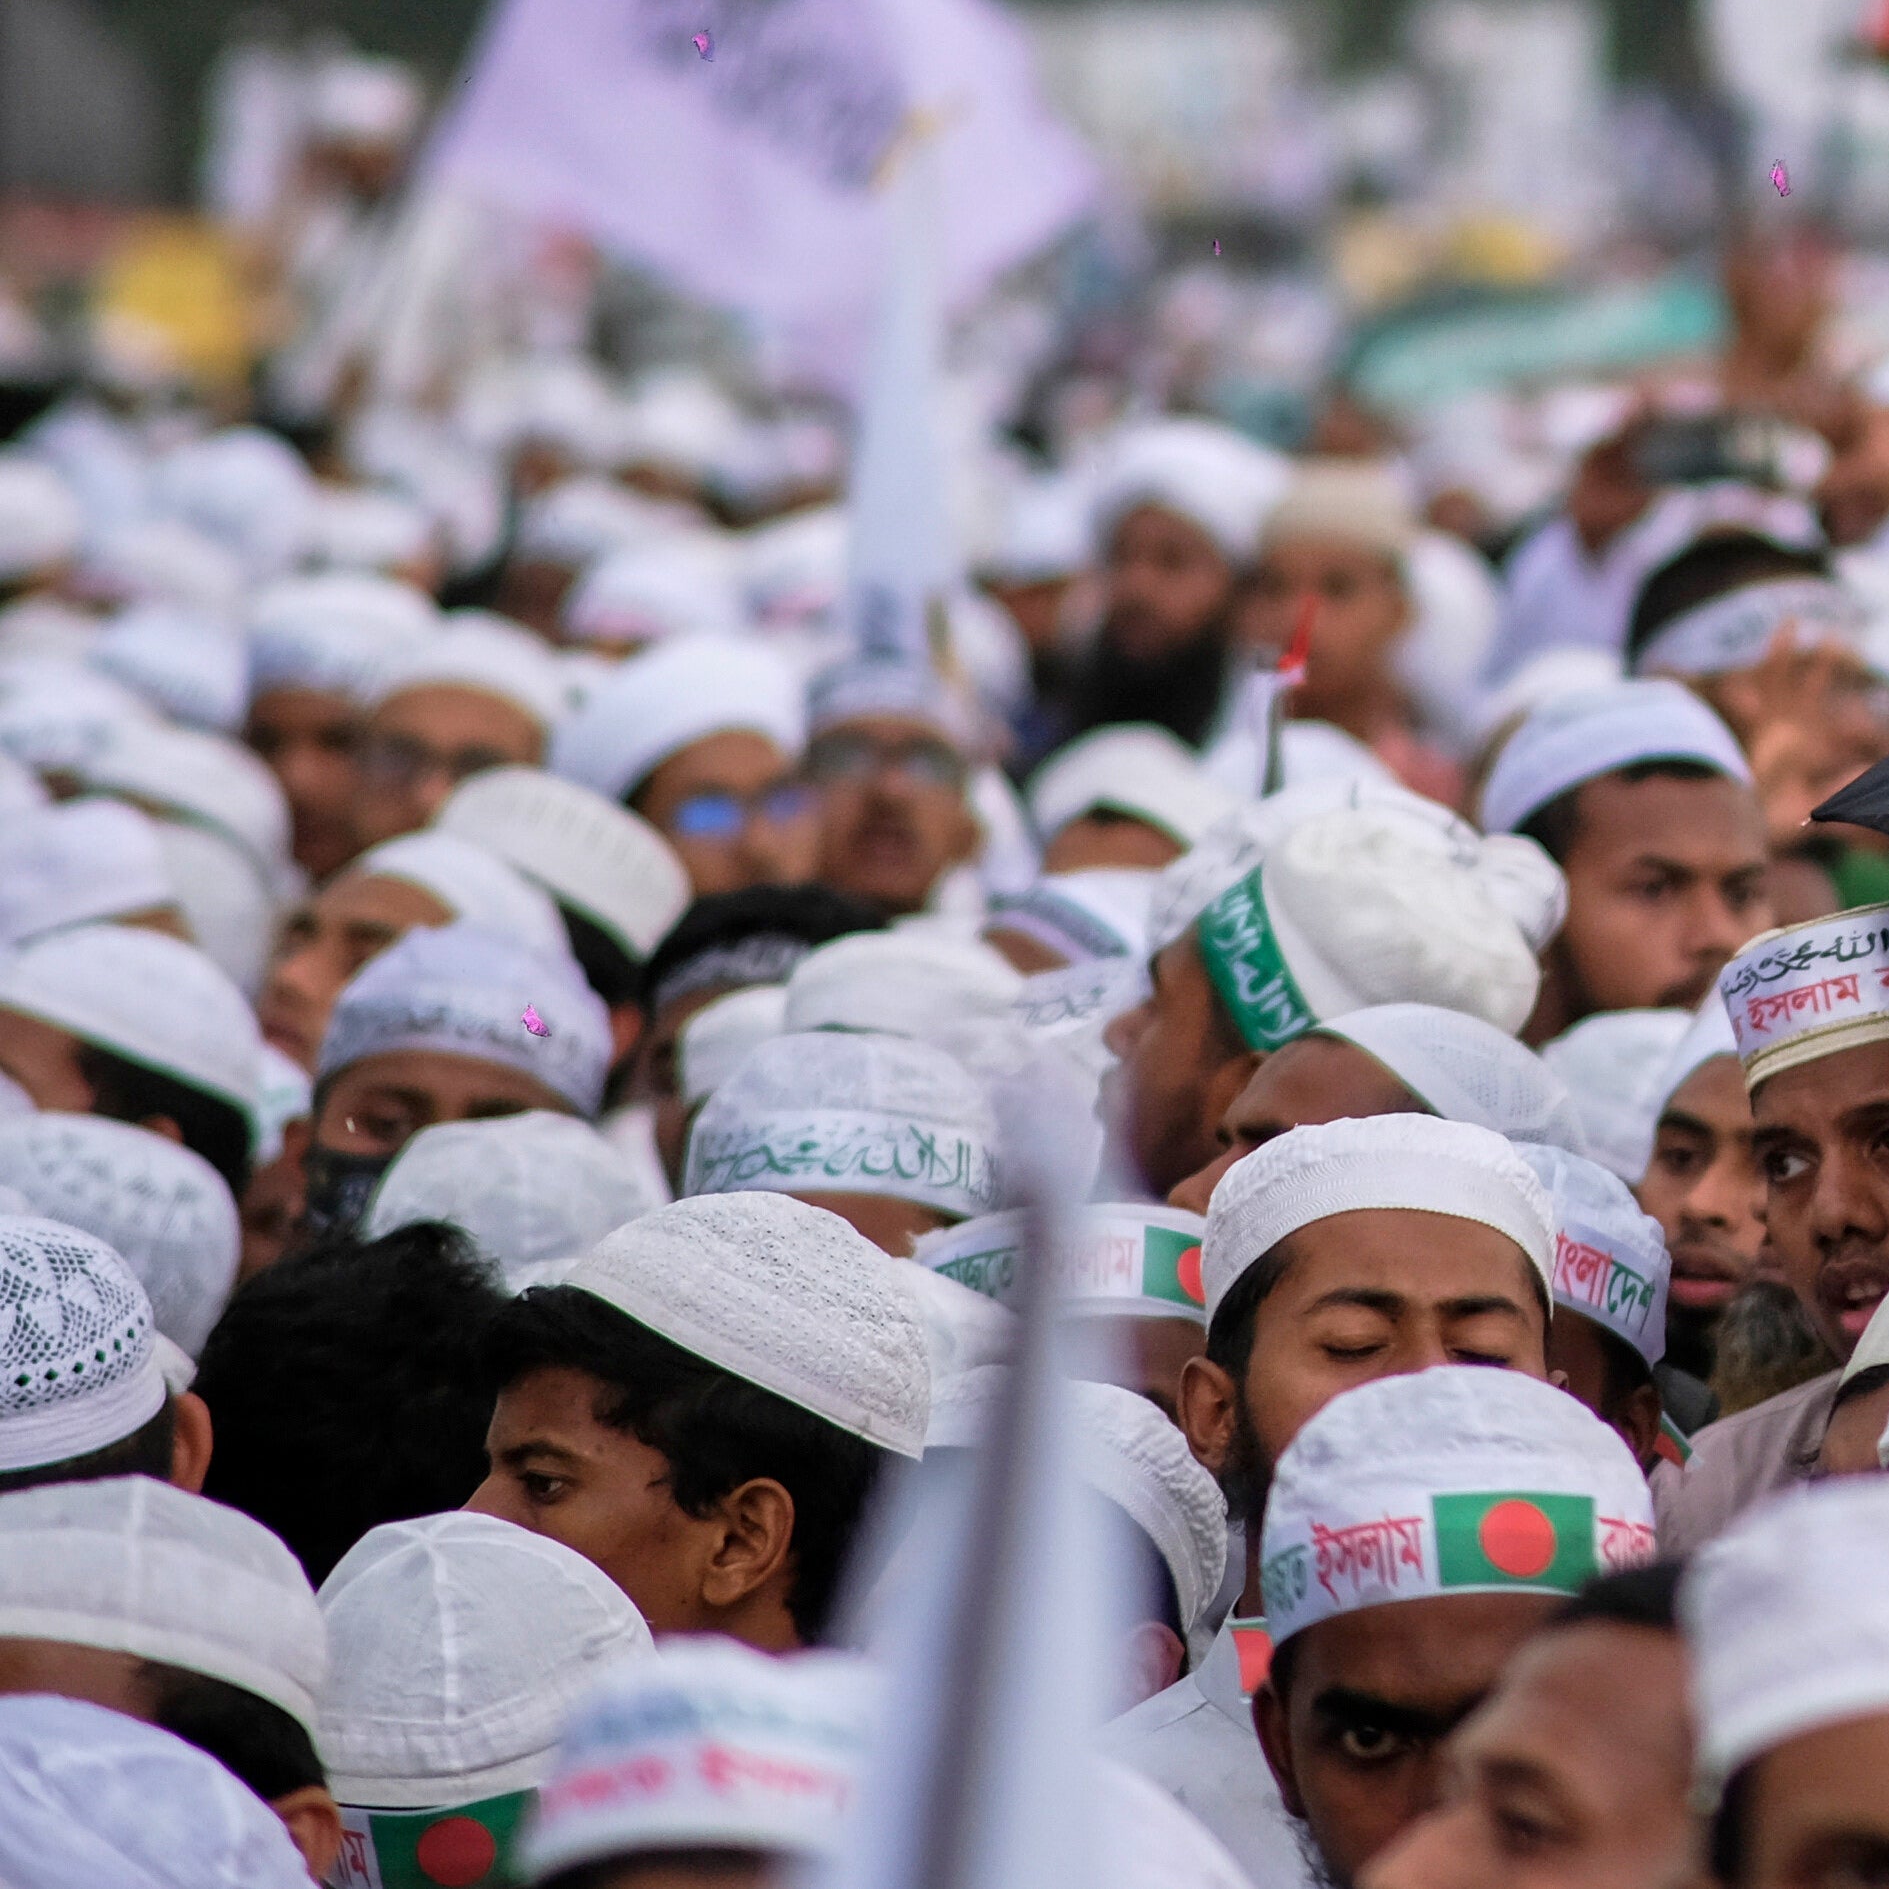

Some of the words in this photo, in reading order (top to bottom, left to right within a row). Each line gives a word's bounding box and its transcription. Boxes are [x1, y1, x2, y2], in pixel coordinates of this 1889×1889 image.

[1747, 972, 1861, 1033] ইসলাম
[1551, 1228, 1656, 1338] াংলাদেশ
[1310, 1512, 1426, 1608] ইসলাম
